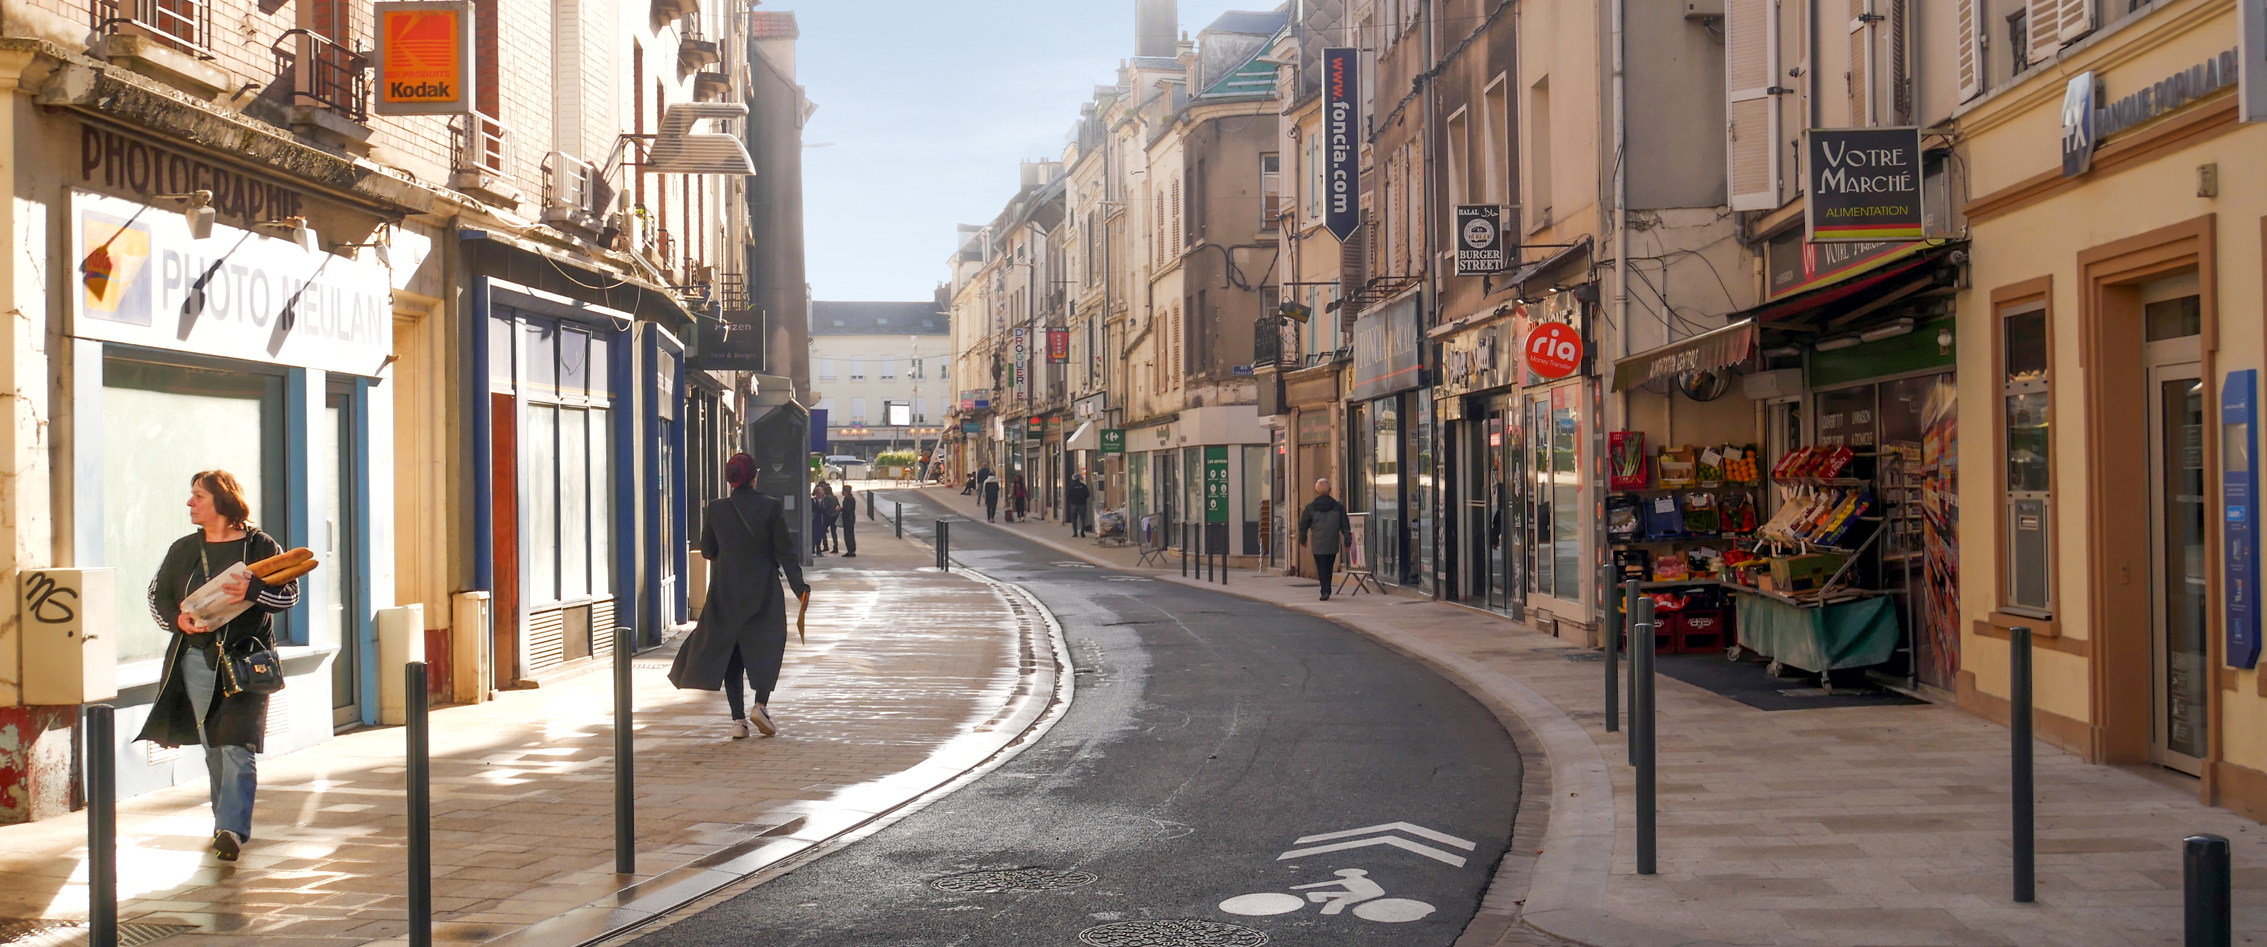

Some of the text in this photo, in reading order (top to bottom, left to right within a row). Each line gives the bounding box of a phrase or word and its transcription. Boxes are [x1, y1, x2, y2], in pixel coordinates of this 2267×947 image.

[403, 70, 451, 78] PRODUITS
[391, 82, 450, 98] Kodak
[1332, 57, 1350, 213] www.foncia.com
[1822, 141, 1908, 168] VOTRE
[82, 123, 303, 230] PHOTOGRAPHIE
[1818, 167, 1915, 194] MARCHÉ
[1826, 206, 1908, 217] ALIMENTATION
[1460, 250, 1500, 260] BURGER
[1460, 260, 1500, 270] STREET
[163, 248, 382, 346] PHOTO MEULAN
[1359, 322, 1412, 368] FONCIA PASCAL
[1532, 329, 1576, 362] ria
[1016, 328, 1024, 401] DROGUERIE
[1530, 355, 1572, 370] Money Transfer
